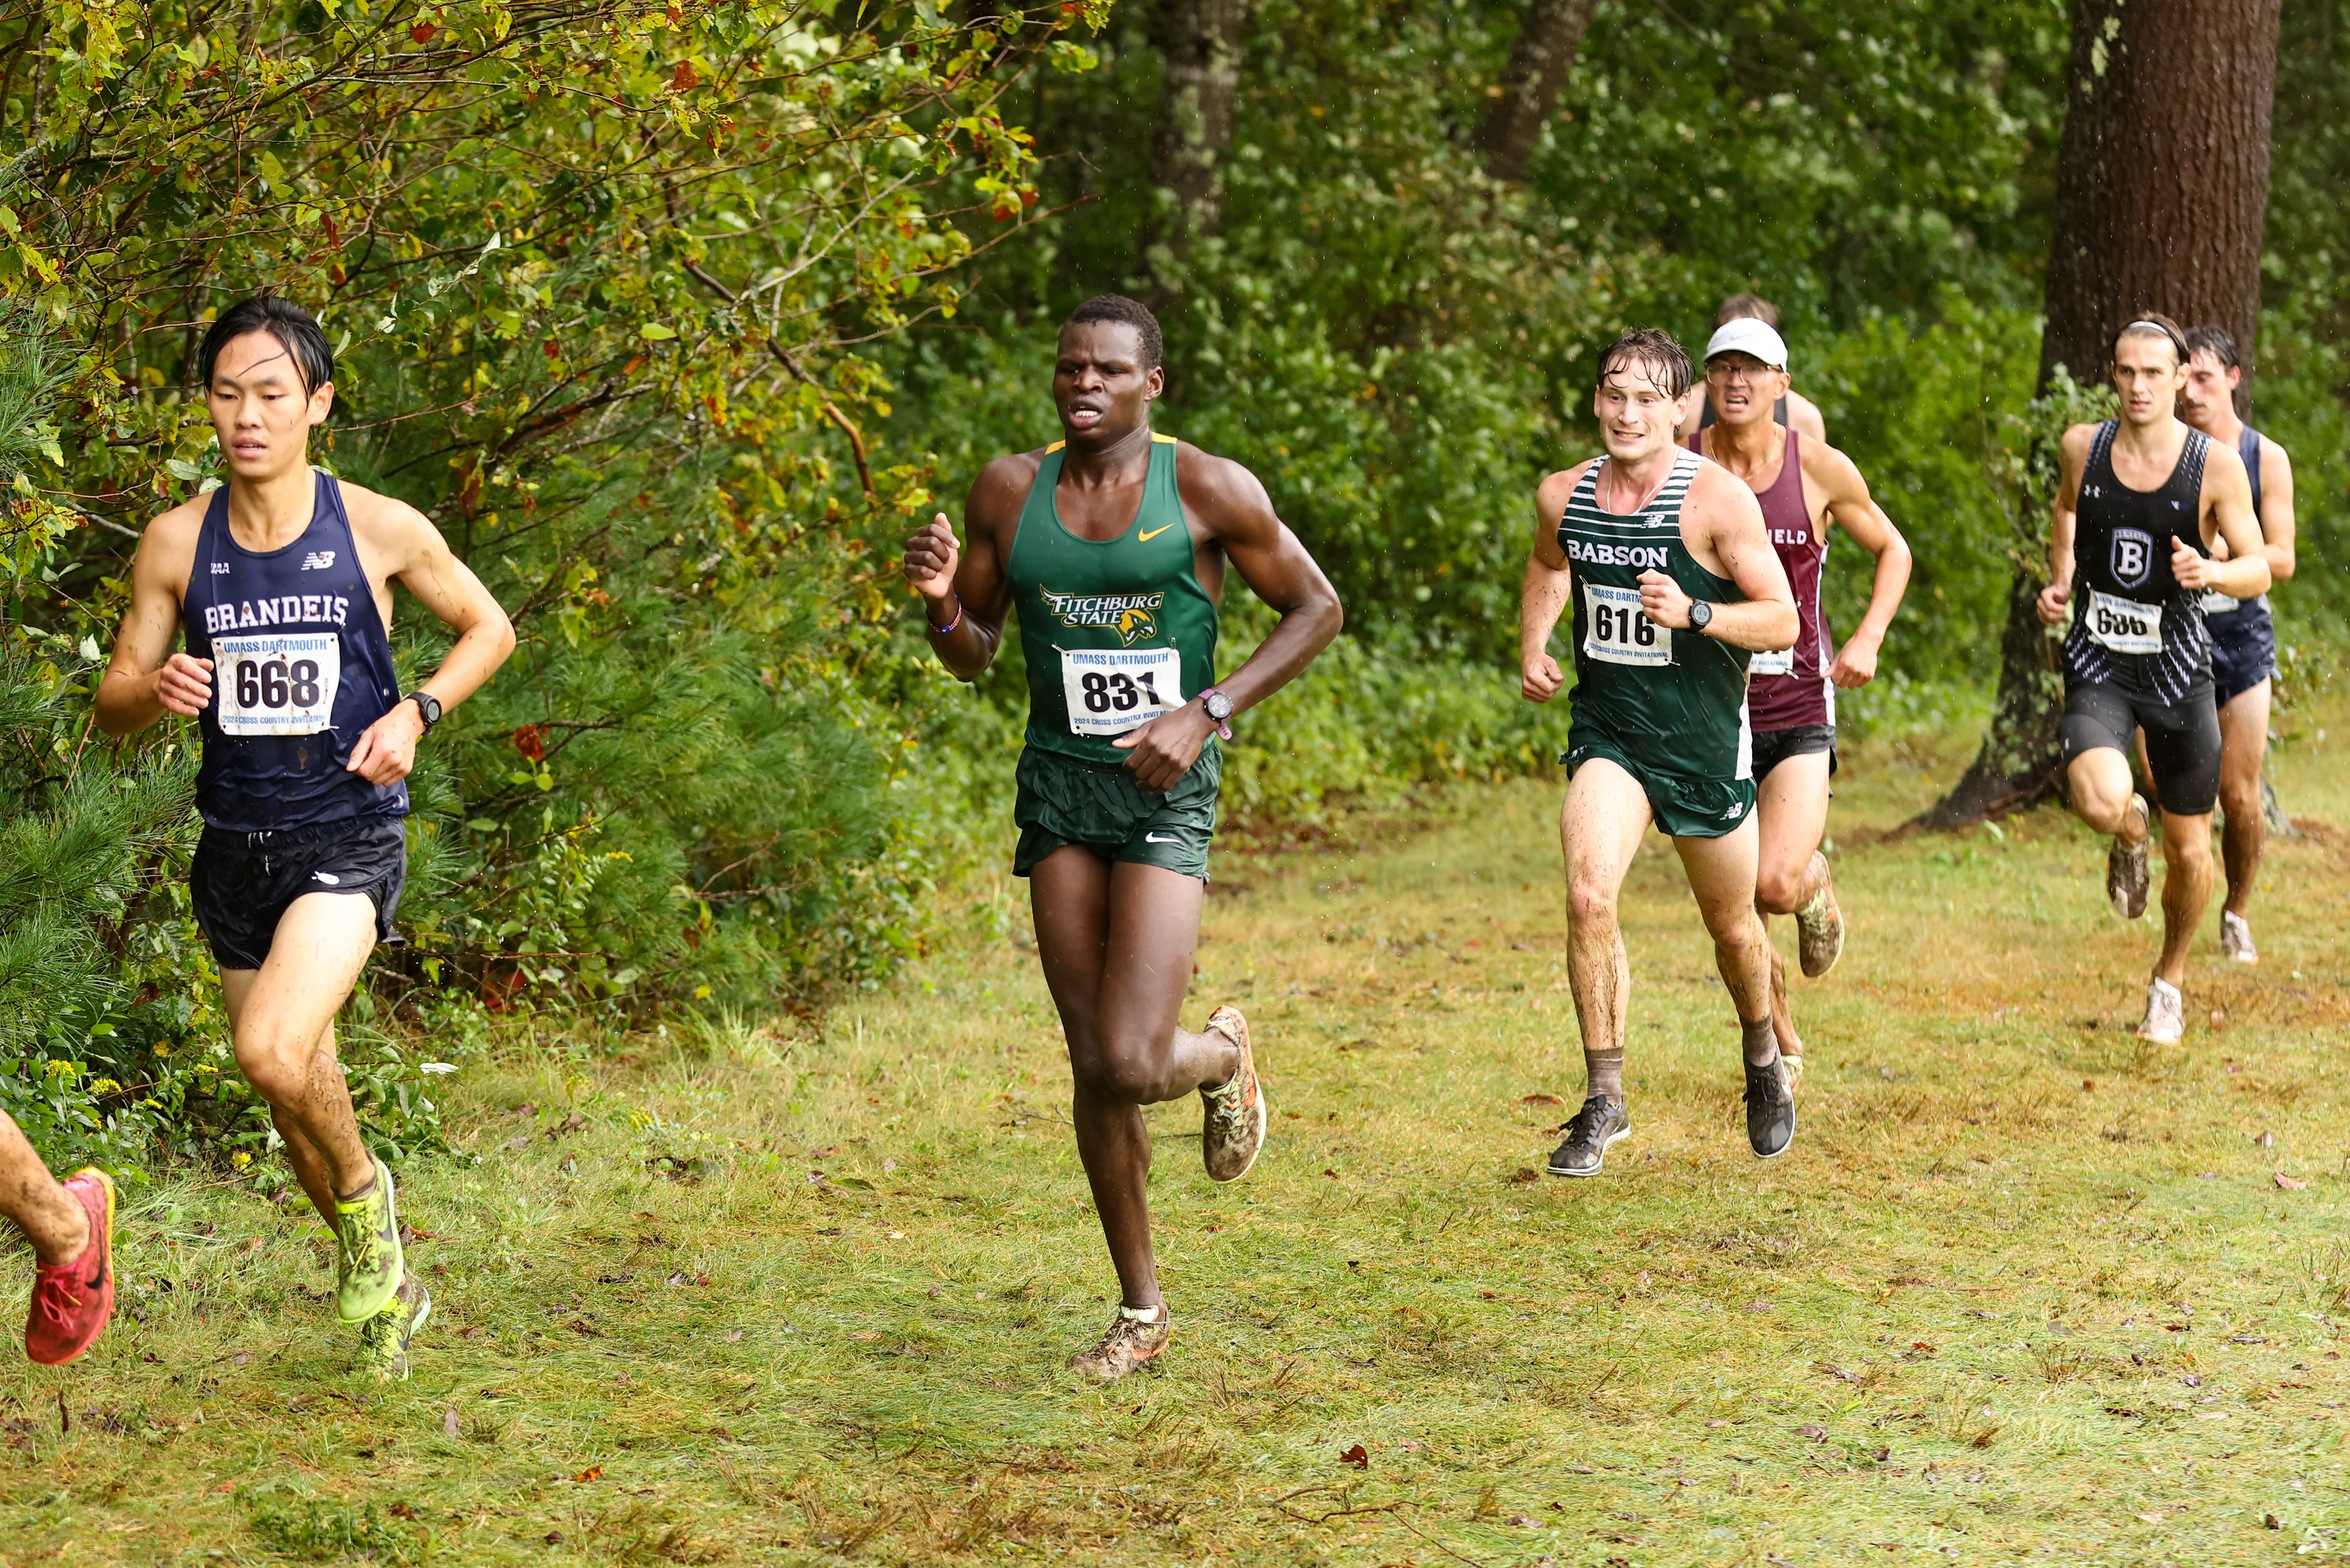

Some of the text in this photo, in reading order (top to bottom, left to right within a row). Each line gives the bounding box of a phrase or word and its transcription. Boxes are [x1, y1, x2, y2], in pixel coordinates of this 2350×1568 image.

[1767, 528, 1808, 545] IELD
[1566, 539, 1669, 568] BABSON
[2117, 540, 2144, 577] B
[1044, 591, 1162, 613] FITCHBURG
[1591, 587, 1642, 604] UMASS DARTM
[204, 595, 349, 634] BRANDEIS
[1063, 610, 1124, 625] STATE
[1595, 604, 1655, 647] 616
[223, 639, 328, 653] UMASS DARTMOUTH
[1073, 652, 1169, 666] UMASS DARTMOUTH
[236, 659, 320, 709] 668
[1081, 671, 1161, 714] 831
[238, 715, 259, 725] CROSS
[260, 716, 289, 725] COUNTRY
[1091, 718, 1112, 726] CROSS
[1113, 713, 1141, 725] COUNTRY
